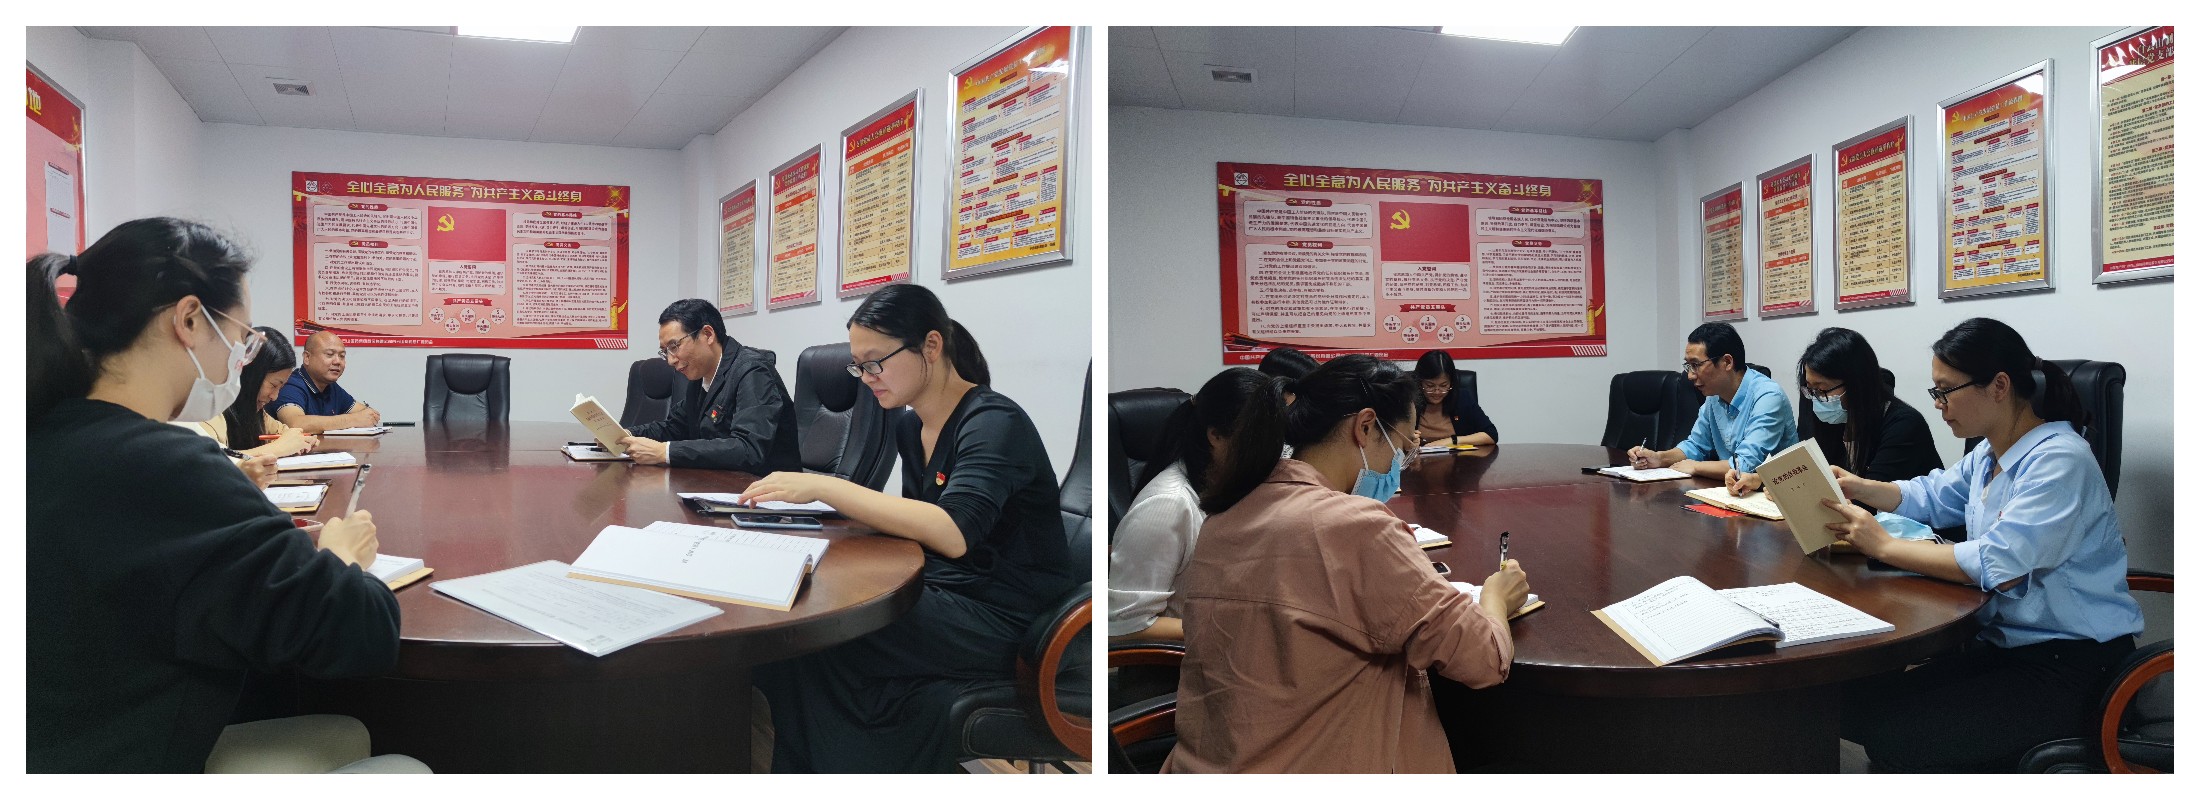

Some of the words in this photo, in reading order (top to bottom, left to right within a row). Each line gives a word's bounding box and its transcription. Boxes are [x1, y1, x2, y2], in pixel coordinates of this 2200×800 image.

[26, 86, 41, 115] 地
[346, 180, 464, 198] 全心全意为人民服务
[470, 184, 582, 203] 为共产主义奋斗终身
[1283, 172, 1421, 192] 全心全意为人民服务
[1428, 179, 1552, 198] 为共产主义奋斗终身
